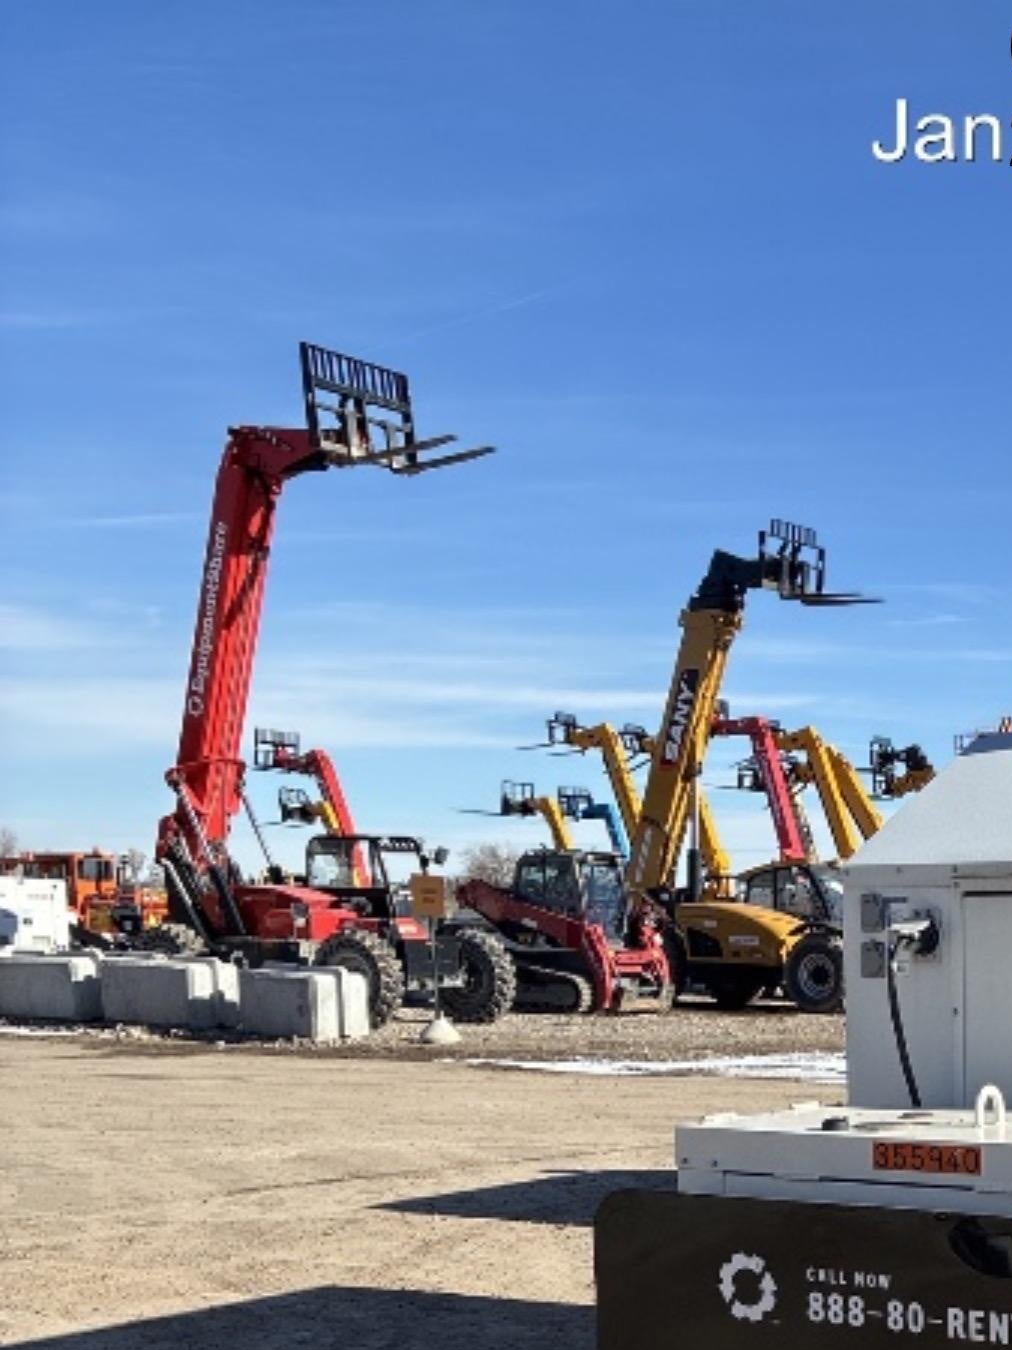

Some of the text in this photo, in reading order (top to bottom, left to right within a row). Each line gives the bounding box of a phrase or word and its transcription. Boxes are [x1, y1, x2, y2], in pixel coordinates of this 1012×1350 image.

[664, 678, 694, 762] SANY
[806, 1267, 893, 1291] CALL NOW
